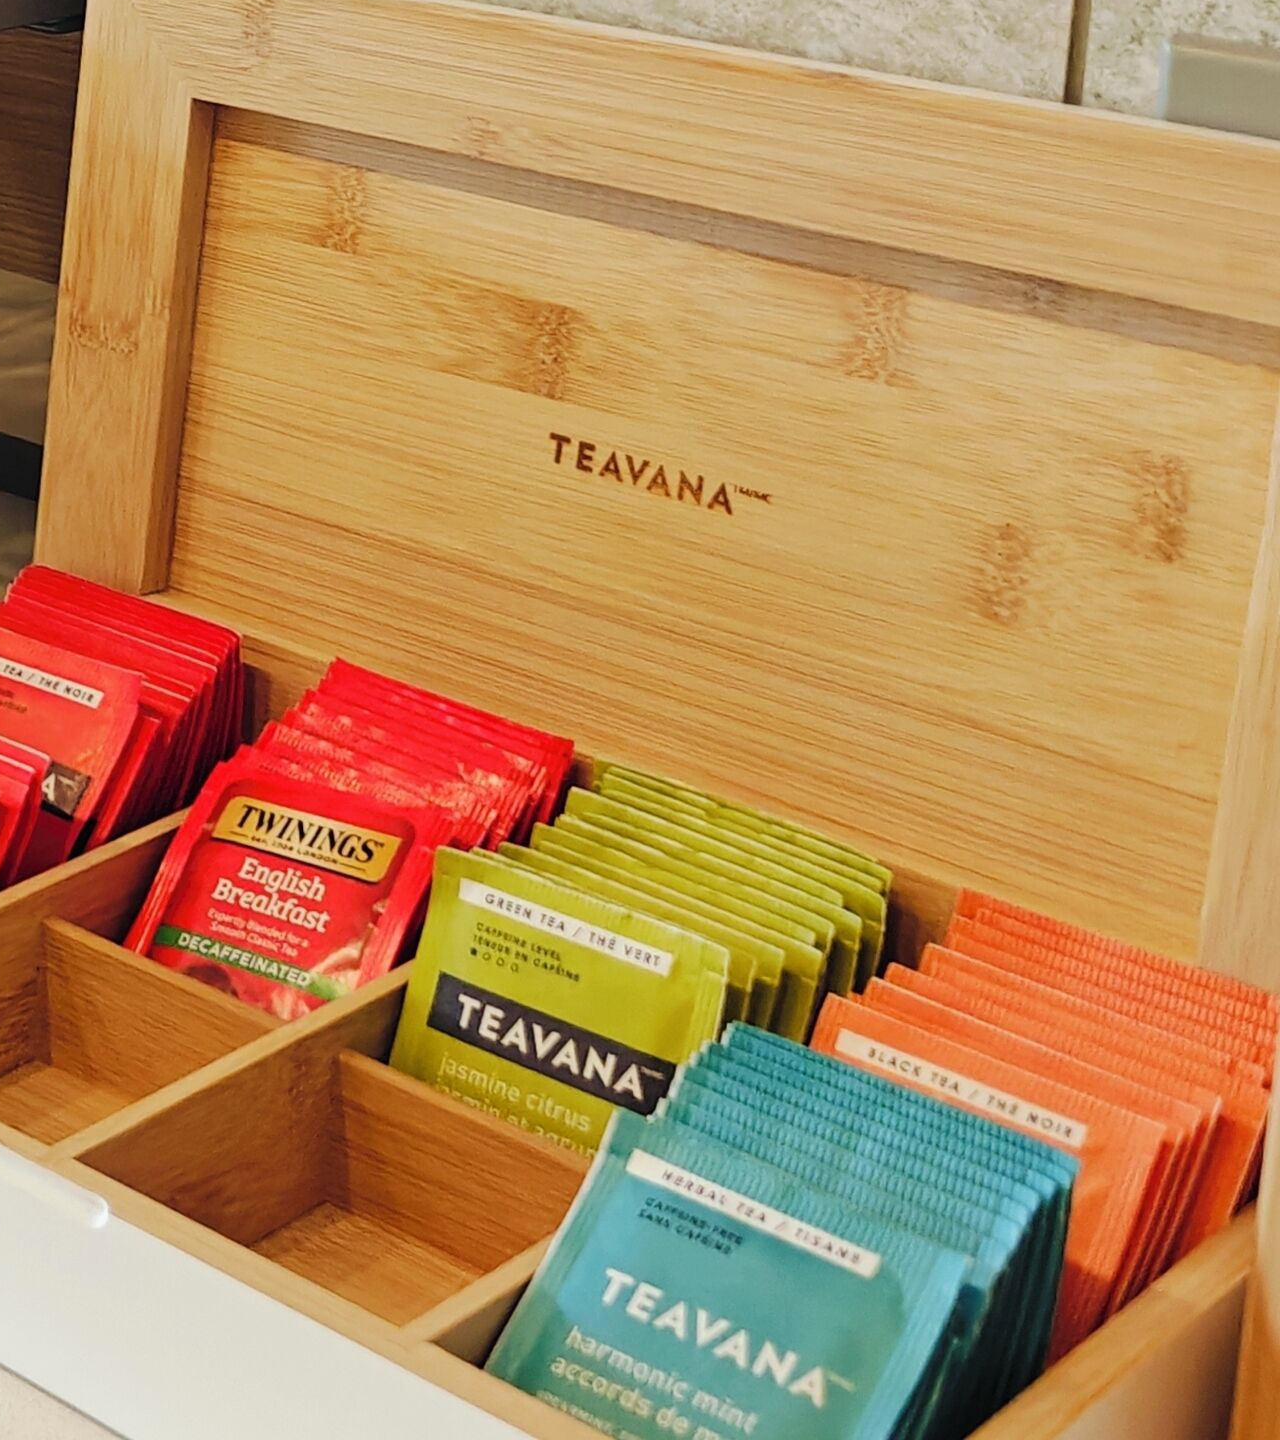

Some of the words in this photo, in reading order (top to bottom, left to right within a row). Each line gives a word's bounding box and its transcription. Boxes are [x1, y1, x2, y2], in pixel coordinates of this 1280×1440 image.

[548, 431, 734, 517] TEAVANA
[2, 664, 23, 678] TEA
[38, 675, 60, 692] THÉ
[64, 684, 95, 703] NOIR
[236, 803, 377, 864] TWININGS
[211, 877, 331, 934] Breakfast
[237, 856, 327, 902] English
[177, 932, 312, 988] DECAFFEINATED
[484, 892, 532, 920] GREEN
[539, 913, 566, 933] TEA
[589, 930, 616, 951] THÉ
[624, 944, 662, 968] VERT
[530, 942, 561, 962] LEVEL
[457, 992, 645, 1102] TEAVANA
[437, 1051, 521, 1103] jasmine
[525, 1090, 592, 1133] citrus
[867, 1046, 921, 1078] BLACK
[930, 1071, 960, 1094] TEA
[1025, 1112, 1073, 1139] NOIR
[660, 1167, 728, 1206] HERBAL
[736, 1200, 768, 1224] TEA
[794, 1227, 861, 1266] TISANE
[600, 1266, 827, 1410] TEAVANA
[549, 1355, 655, 1419] accords
[654, 1404, 691, 1436] de
[564, 1324, 691, 1402] harmonic
[691, 1388, 760, 1436] mint
